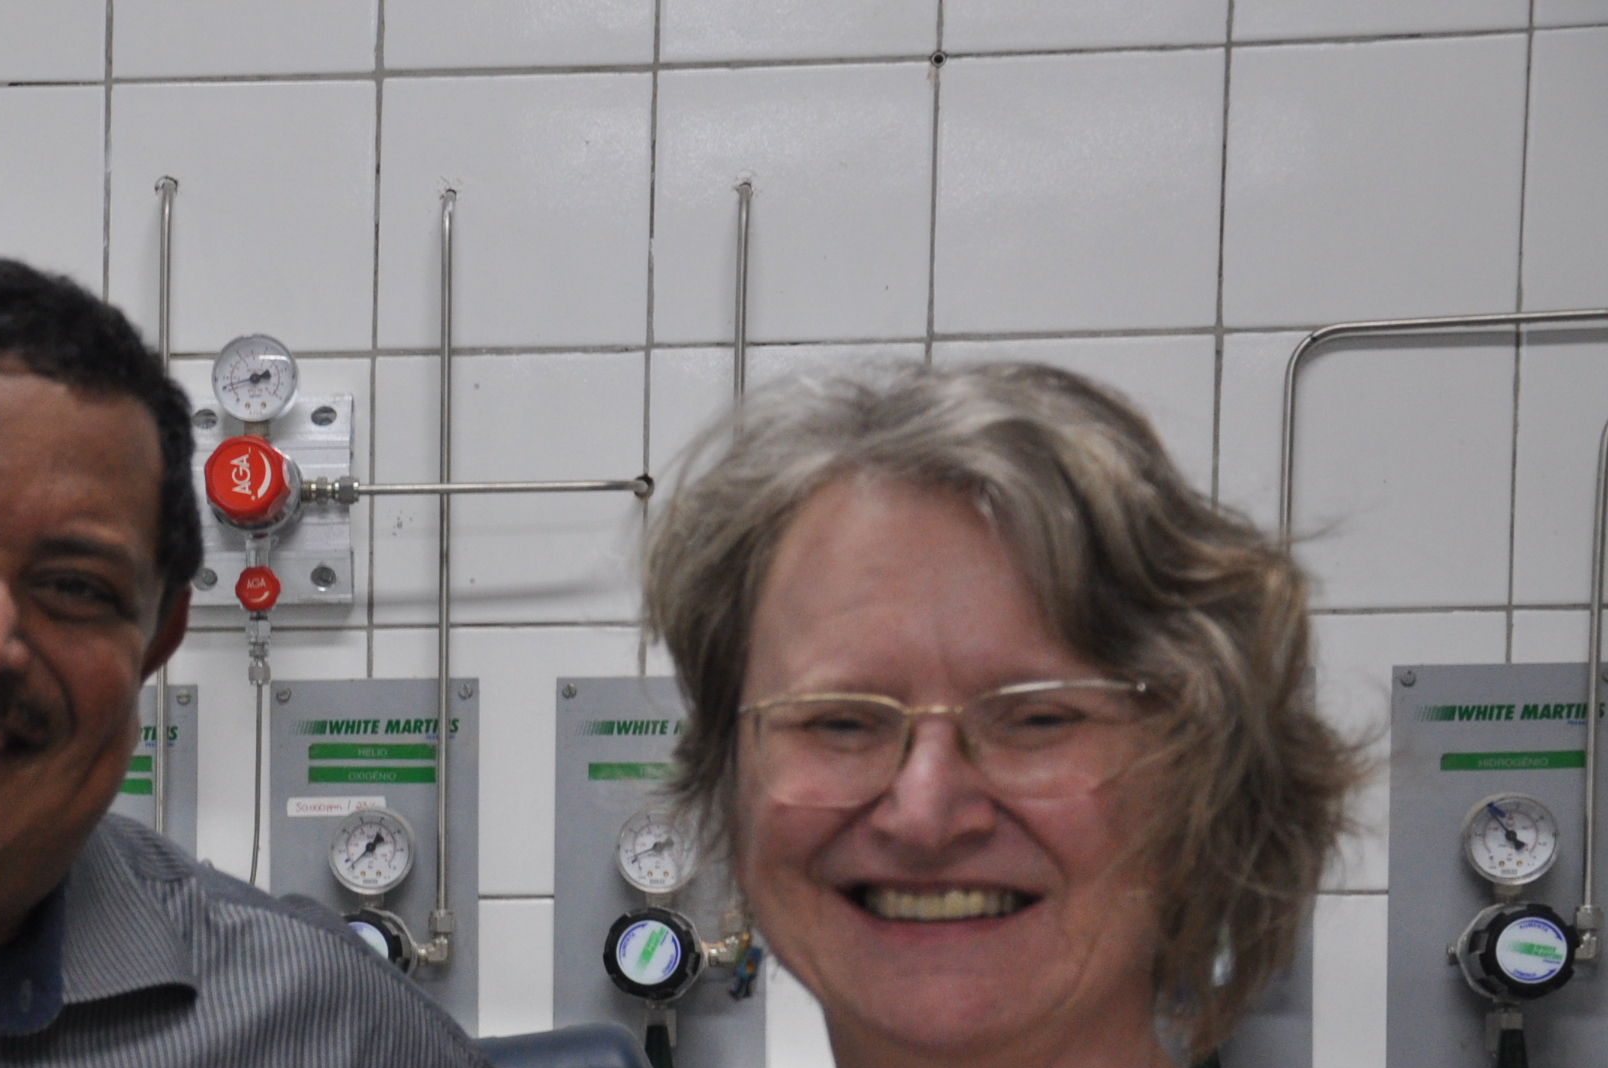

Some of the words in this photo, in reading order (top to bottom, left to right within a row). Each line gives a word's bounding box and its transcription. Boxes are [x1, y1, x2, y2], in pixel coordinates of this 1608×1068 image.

[230, 453, 252, 495] AGA
[247, 577, 267, 590] AGA
[1457, 705, 1516, 721] WHITE
[328, 719, 381, 735] WHITE
[384, 719, 460, 735] MARTIS
[617, 720, 669, 735] WHITE
